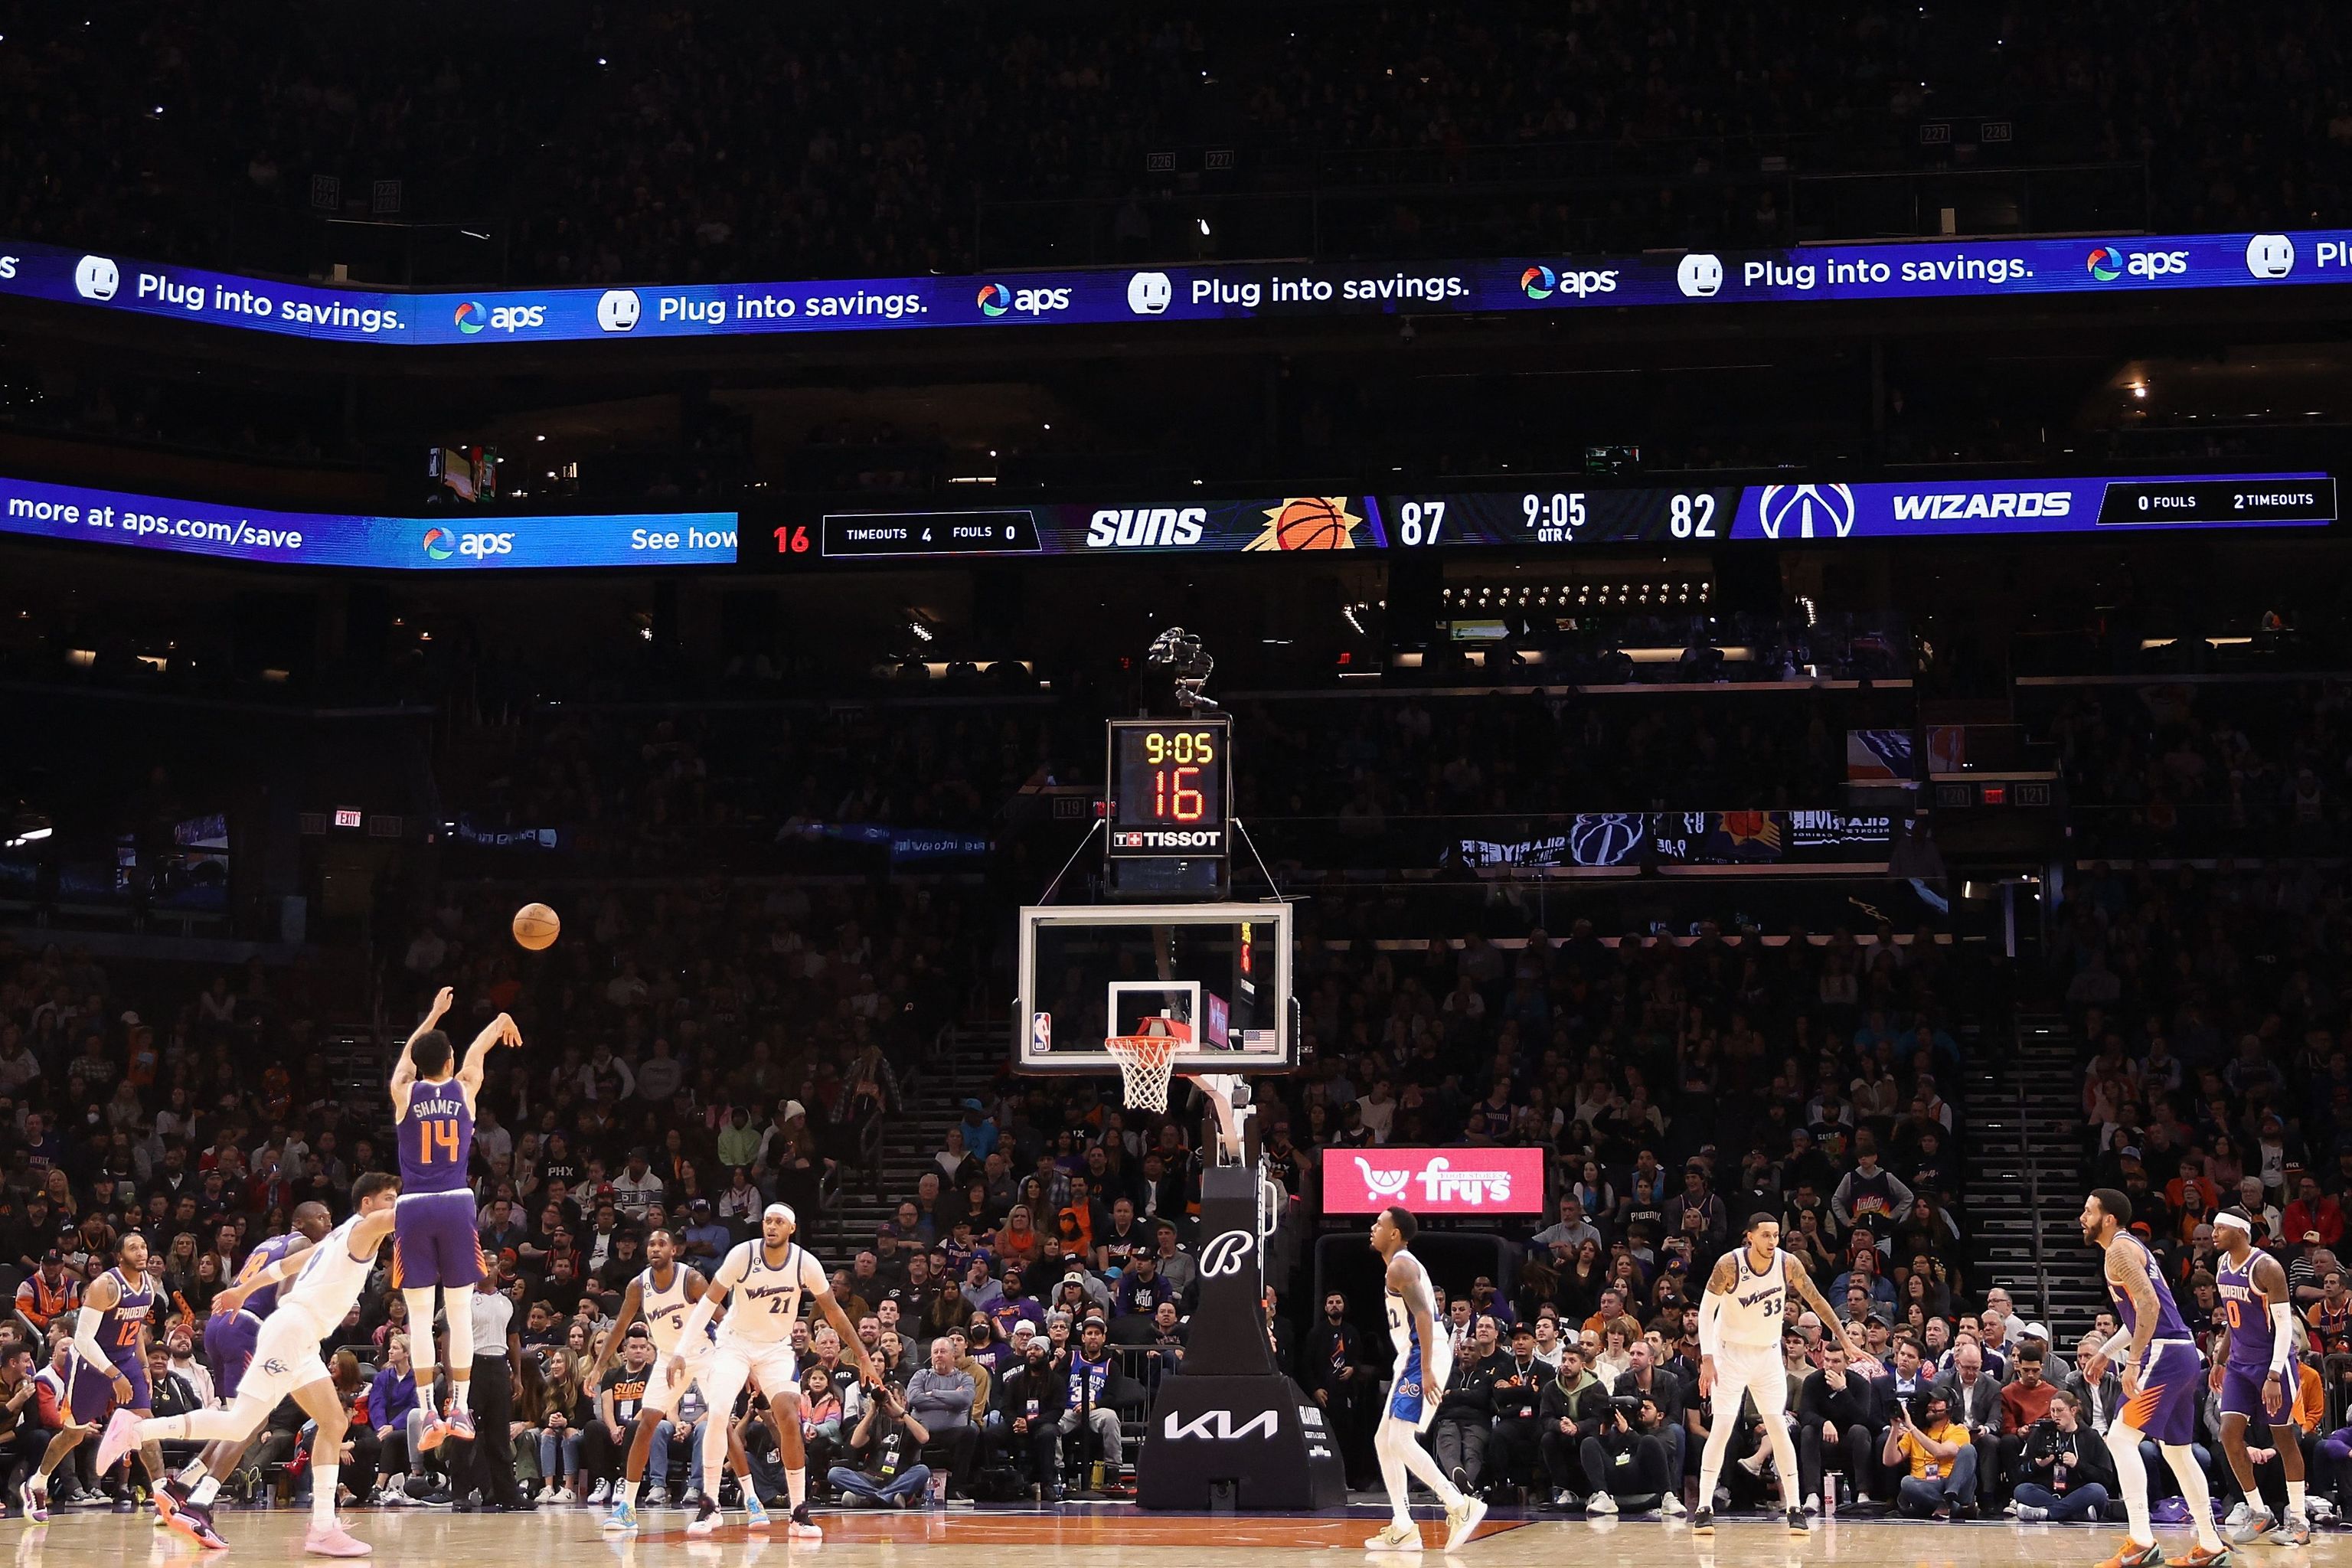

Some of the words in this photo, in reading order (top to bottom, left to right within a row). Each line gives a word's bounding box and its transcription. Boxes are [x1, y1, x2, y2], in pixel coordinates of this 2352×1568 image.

[2128, 252, 2189, 279] aps
[2318, 242, 2352, 267] Pl
[1560, 271, 1619, 298] aps
[1745, 261, 1815, 289] Plug
[1828, 260, 1890, 283] into
[1902, 255, 2033, 283] savings.
[1015, 289, 1072, 315] aps
[1193, 279, 1259, 306] Plug
[1273, 277, 1332, 301] into
[1344, 273, 1468, 301] savings.
[139, 274, 204, 310] Plug
[216, 285, 272, 315] into
[282, 302, 404, 332] savings.
[660, 297, 725, 324] Plug
[737, 295, 795, 318] into
[805, 291, 926, 318] savings.
[491, 306, 546, 332] aps
[1524, 494, 1585, 527] 9:05
[1894, 492, 2071, 520] WIZARDS
[2138, 496, 2148, 510] 0
[2154, 497, 2195, 507] FOULS
[2234, 495, 2243, 508] 2
[2247, 494, 2313, 505] TIMEOUTS
[9, 499, 79, 523] more
[88, 507, 114, 527] at
[122, 513, 302, 547] aps.com/save
[1087, 508, 1207, 547] SUNS
[1402, 502, 1445, 545] 87
[1671, 495, 1715, 537] 82
[632, 529, 679, 549] See
[774, 527, 808, 552] 16
[847, 529, 906, 539] TIMEOUTS
[923, 528, 931, 541] 4
[954, 527, 991, 537] FOULS
[1006, 526, 1014, 539] 0
[1538, 530, 1563, 541] QTR
[1565, 528, 1573, 541] 4
[460, 533, 514, 559] aps
[1146, 733, 1212, 763] 9:05
[1157, 767, 1202, 820] 16
[340, 812, 357, 825] EXIT
[1144, 832, 1220, 846] TISSOT
[413, 1099, 462, 1118] SHAMET
[420, 1119, 459, 1164] 14
[548, 1167, 573, 1177] PHX
[1415, 1157, 1511, 1206] fry's
[1631, 1211, 1661, 1222] PHOENIX
[1200, 1230, 1253, 1277] B
[769, 1297, 792, 1315] 21
[1763, 1298, 1782, 1317] 33
[2226, 1299, 2241, 1328] 0
[116, 1321, 136, 1346] 12
[671, 1315, 683, 1329] 5
[613, 1380, 645, 1396] SUNS
[1165, 1411, 1277, 1439] KIA
